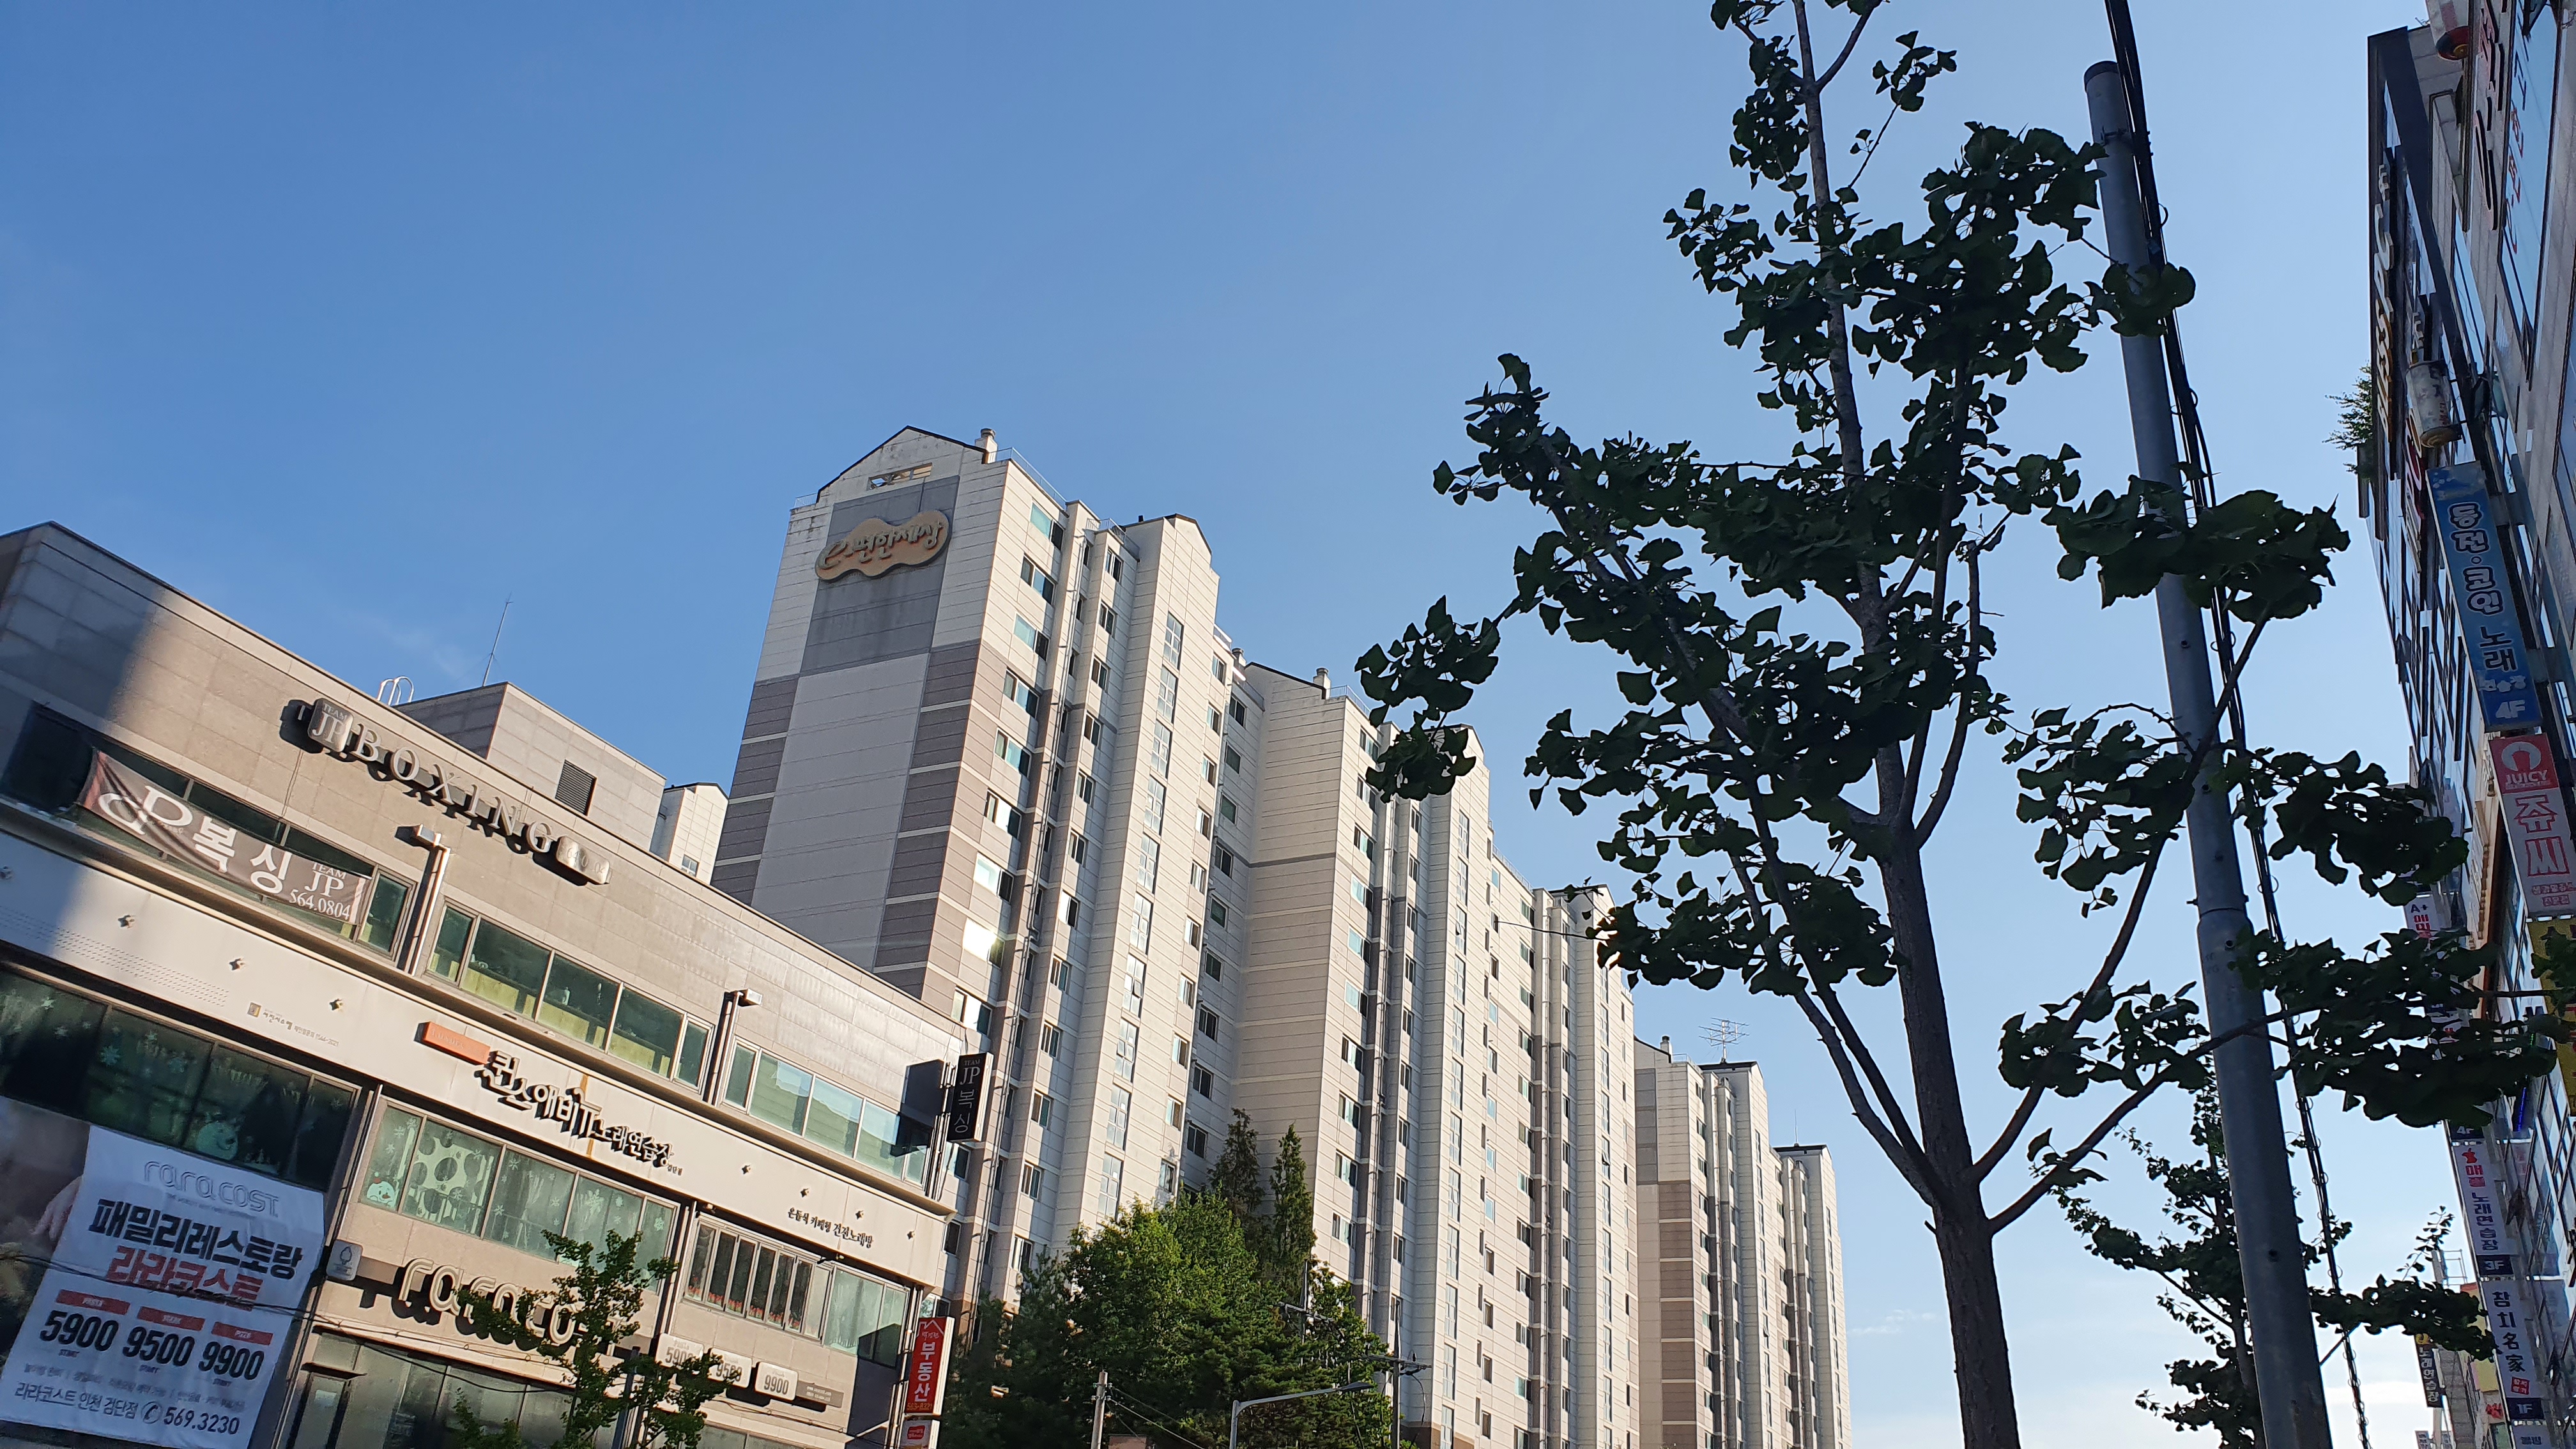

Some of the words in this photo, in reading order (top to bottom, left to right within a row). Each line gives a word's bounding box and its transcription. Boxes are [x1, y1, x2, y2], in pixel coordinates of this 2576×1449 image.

[2374, 203, 2393, 322] PC
[2480, 626, 2518, 671] 노래
[312, 710, 346, 744] JP
[323, 703, 348, 721] TEAM
[2496, 700, 2526, 719] 4F
[351, 723, 554, 854] BOXING
[2506, 769, 2548, 785] JUICY
[192, 816, 293, 894] 복싱
[2514, 794, 2570, 877] 쥬씨
[305, 870, 345, 897] JP
[312, 862, 346, 880] TEAM
[289, 888, 350, 919] 564.0804
[959, 1066, 981, 1085] JP
[480, 1050, 602, 1137] 퀸스애비뉴
[592, 1118, 674, 1167] 노래연습장
[954, 1089, 975, 1133] 복싱
[88, 1199, 304, 1280] 패밀리레스토랑
[2472, 1192, 2499, 1251] 노래연습장
[106, 1245, 264, 1311] 라라코스트
[2484, 1260, 2505, 1271] 3F
[40, 1310, 119, 1352] 5900
[122, 1326, 195, 1367] 9500
[198, 1341, 264, 1381] 9900
[2492, 1291, 2526, 1372] 참치名家
[763, 1374, 790, 1395] 9900
[914, 1342, 935, 1402] 부동산
[15, 1382, 77, 1406] 라라코스트
[78, 1392, 103, 1413] 인천
[103, 1397, 139, 1420] 검단점
[164, 1407, 240, 1435] 569.3230
